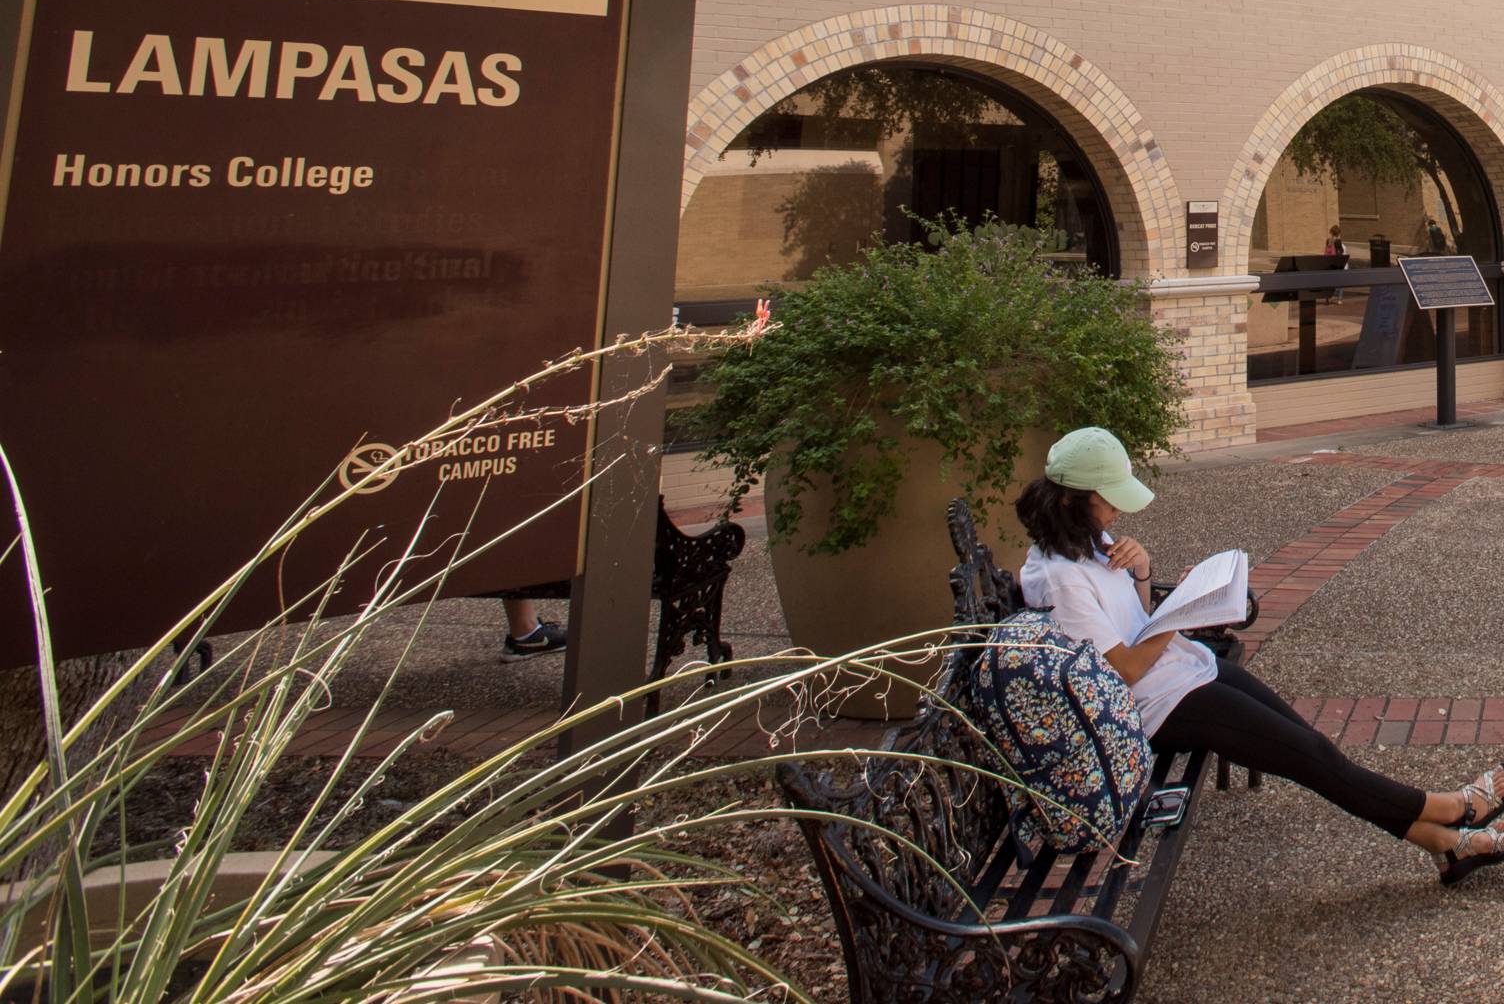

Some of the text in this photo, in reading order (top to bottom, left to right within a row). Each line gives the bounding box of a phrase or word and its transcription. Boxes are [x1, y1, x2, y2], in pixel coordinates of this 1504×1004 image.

[65, 30, 523, 108] LAMPASAS
[52, 154, 374, 195] Honors College
[507, 429, 556, 451] FREE
[438, 456, 517, 482] CAMPUS
